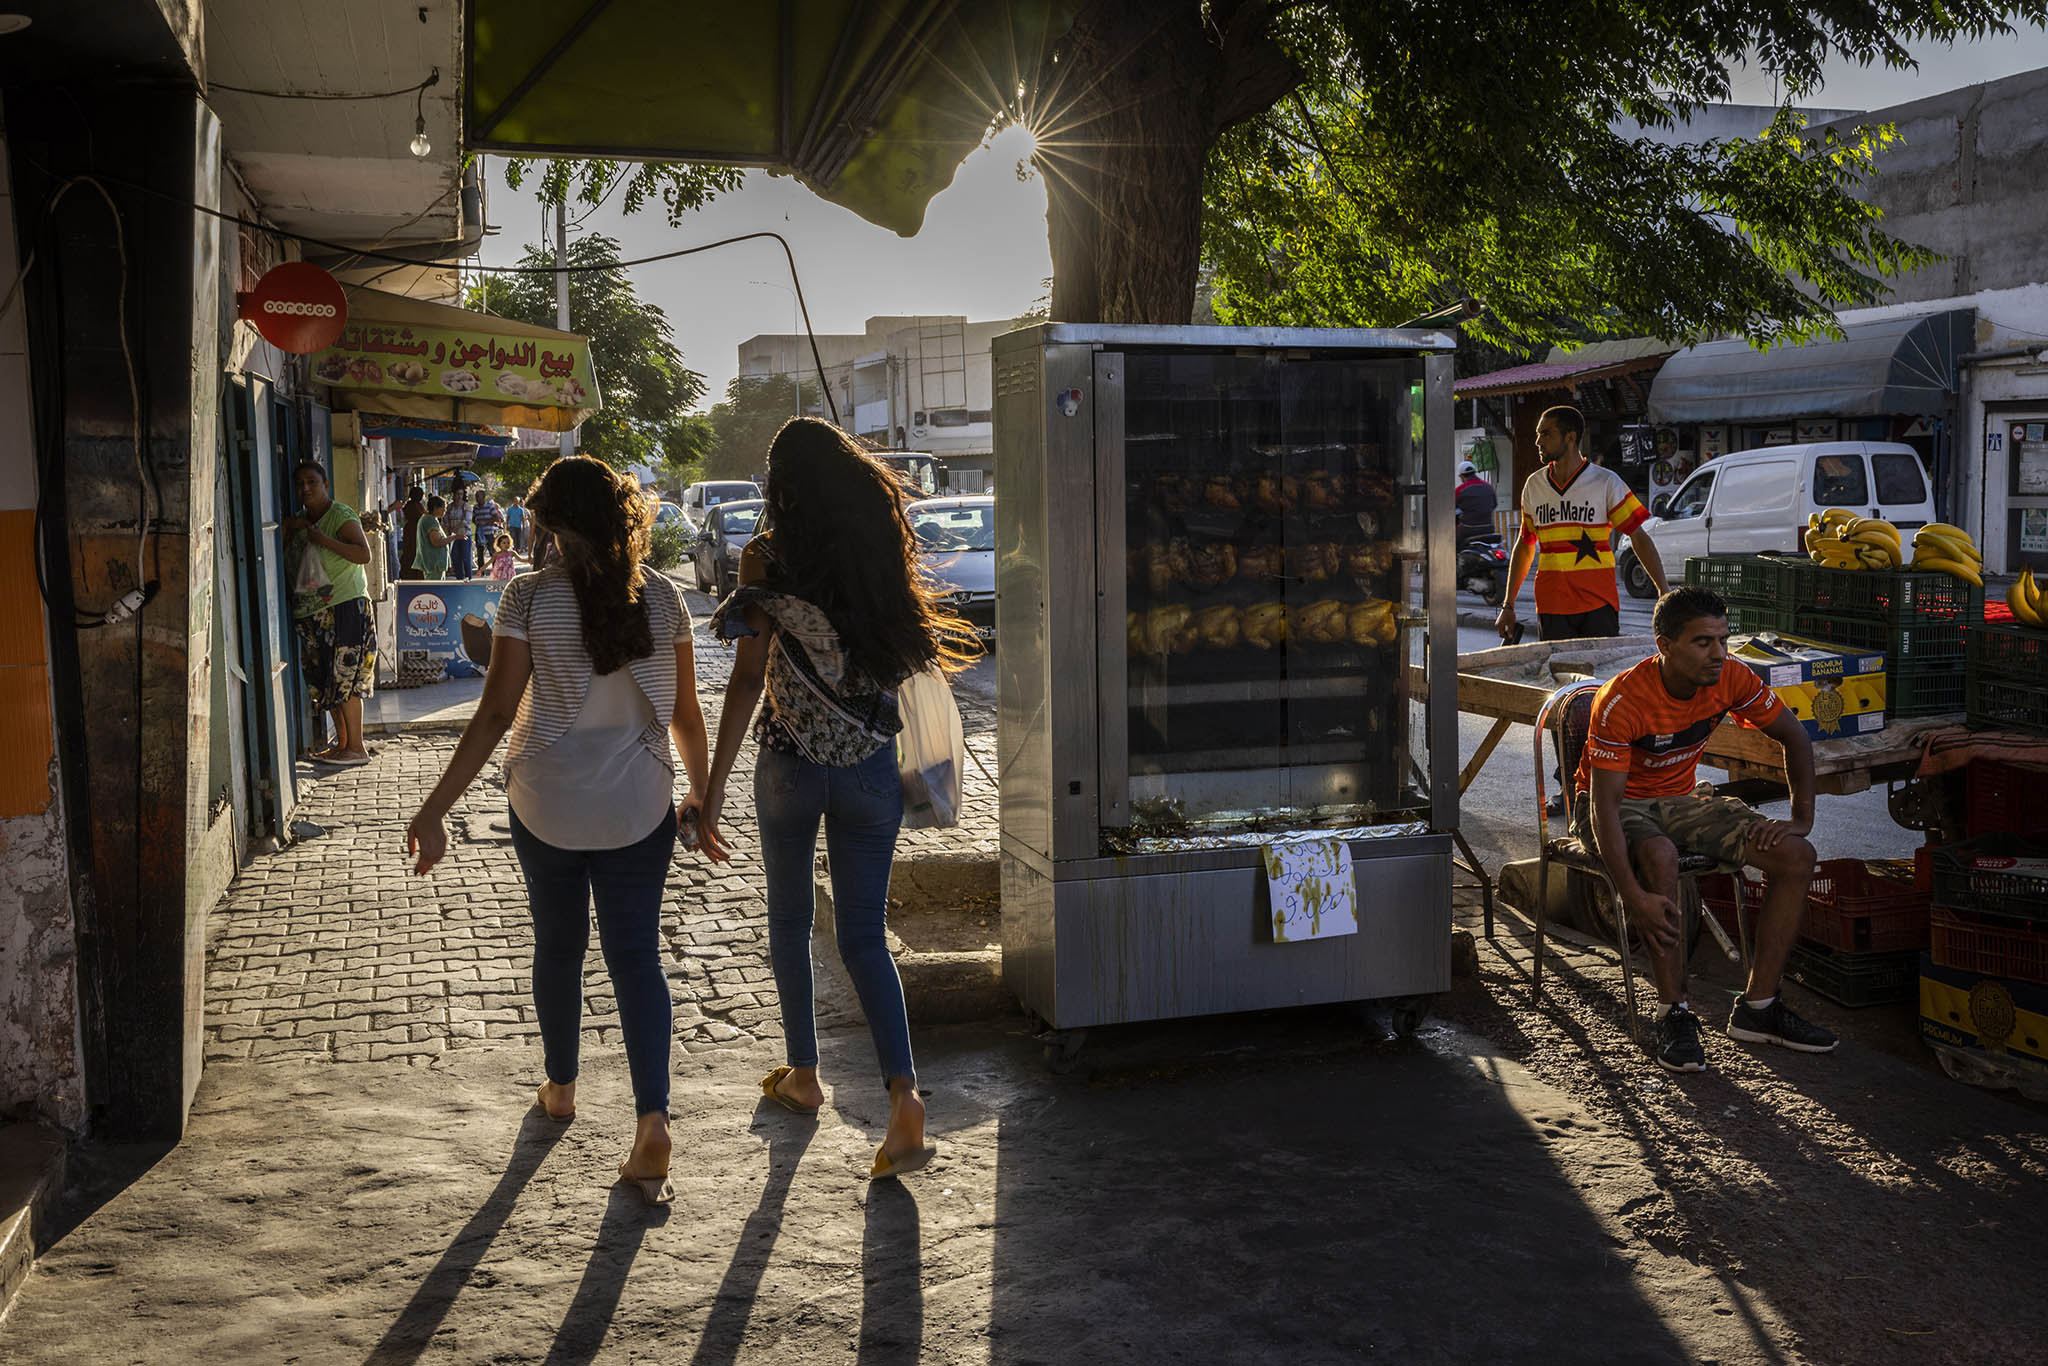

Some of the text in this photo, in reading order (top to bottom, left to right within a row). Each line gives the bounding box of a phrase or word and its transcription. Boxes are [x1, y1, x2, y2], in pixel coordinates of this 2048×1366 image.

[264, 300, 336, 317] ooredoo
[450, 337, 536, 369] الدواجن
[539, 350, 574, 378] بيع
[1812, 660, 1843, 669] PREMIUM
[1812, 667, 1844, 676] BANANAS
